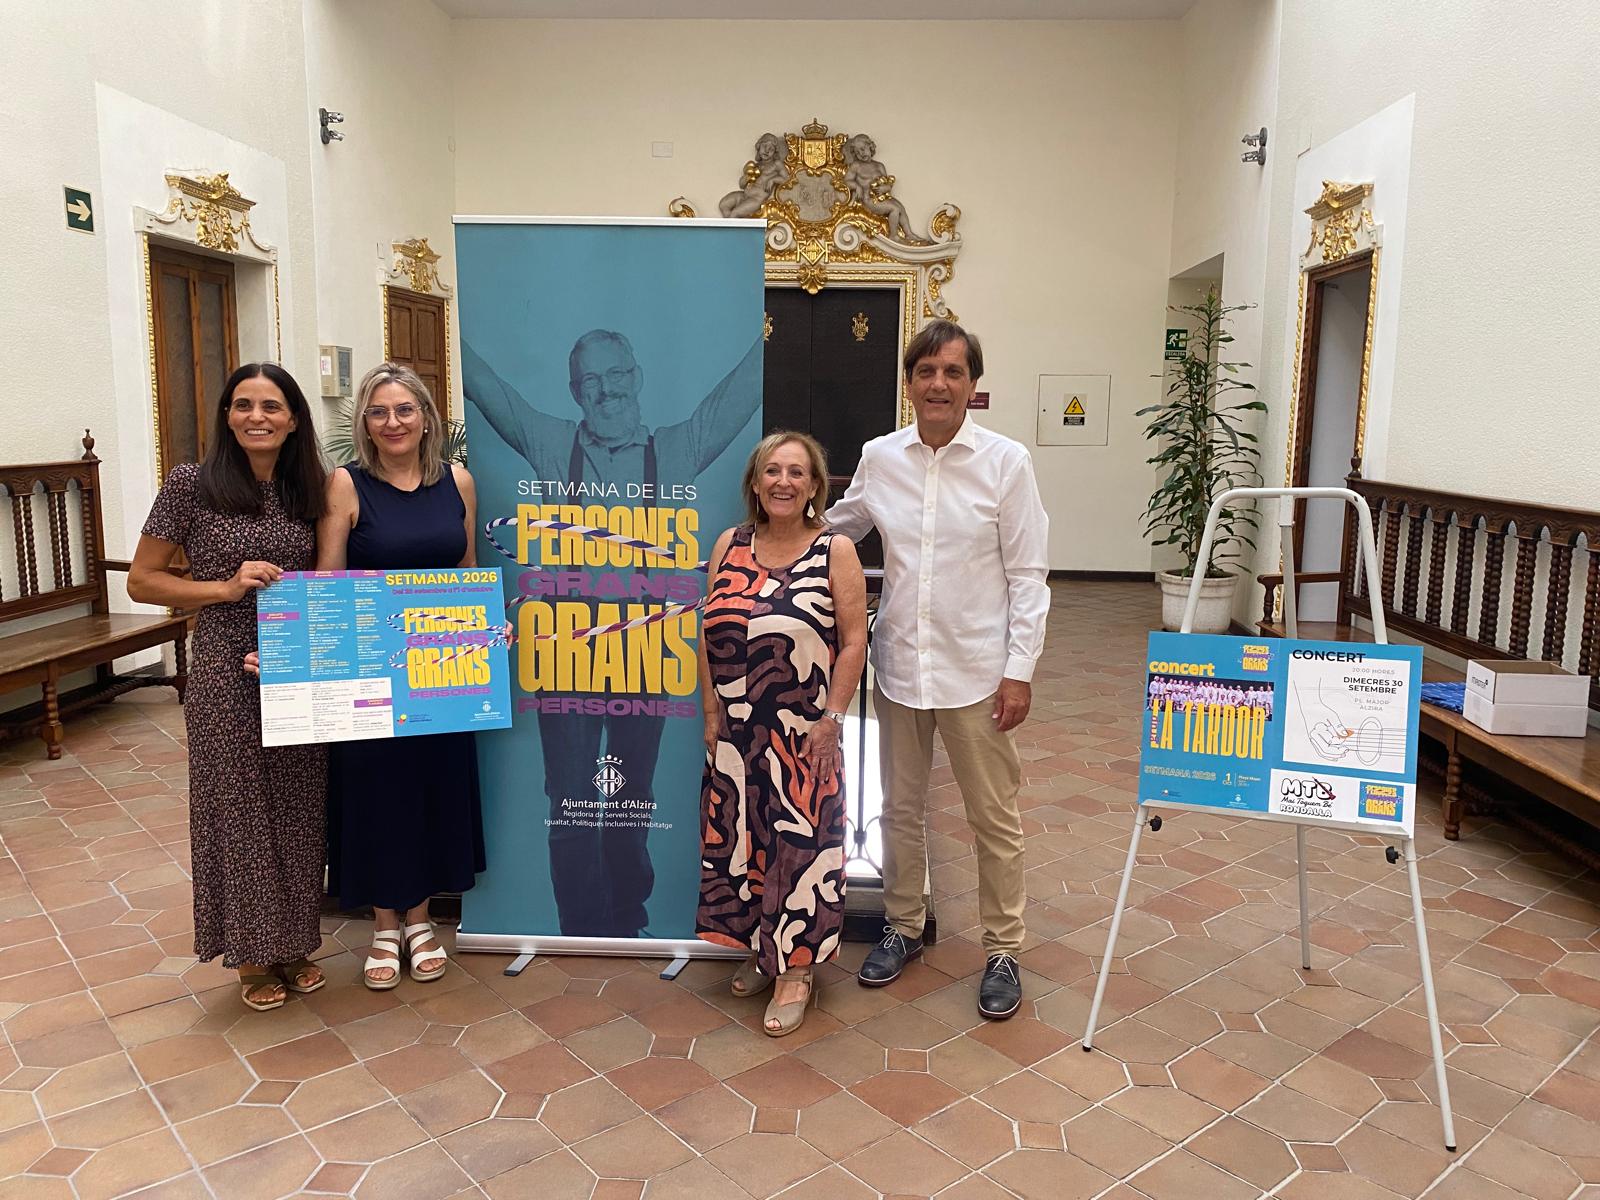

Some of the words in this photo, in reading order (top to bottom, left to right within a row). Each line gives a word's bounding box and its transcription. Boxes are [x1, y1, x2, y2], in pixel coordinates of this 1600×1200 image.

[517, 480, 620, 498] SETMANA
[626, 483, 654, 499] DE
[660, 485, 697, 500] LES
[517, 503, 699, 570] PERSONES
[385, 573, 459, 586] SETMANA
[462, 571, 498, 584] 2026
[517, 571, 701, 599] GRANS
[403, 605, 488, 634] PERSONES
[406, 632, 489, 647] GRANS
[517, 600, 698, 697] GRANS
[1292, 649, 1366, 664] CONCERT
[406, 645, 491, 690] GRANS
[1149, 660, 1215, 677] concert
[1343, 676, 1390, 686] DIMECRES
[408, 686, 492, 699] PERSONES
[1348, 685, 1397, 694] SETEMBRE
[517, 697, 698, 719] PERSONES
[1183, 700, 1266, 761] TARDOR
[1281, 778, 1334, 800] MTB
[561, 798, 619, 810] Ajuntament
[621, 799, 658, 810] d'Alzira
[1280, 803, 1333, 817] RONDALLA
[563, 810, 594, 819] Regidoria
[604, 811, 629, 819] Serveis
[629, 812, 653, 820] Socials,
[544, 819, 571, 827] Igualtat,
[604, 820, 637, 828] Inclusives
[641, 821, 673, 829] Habitatge
